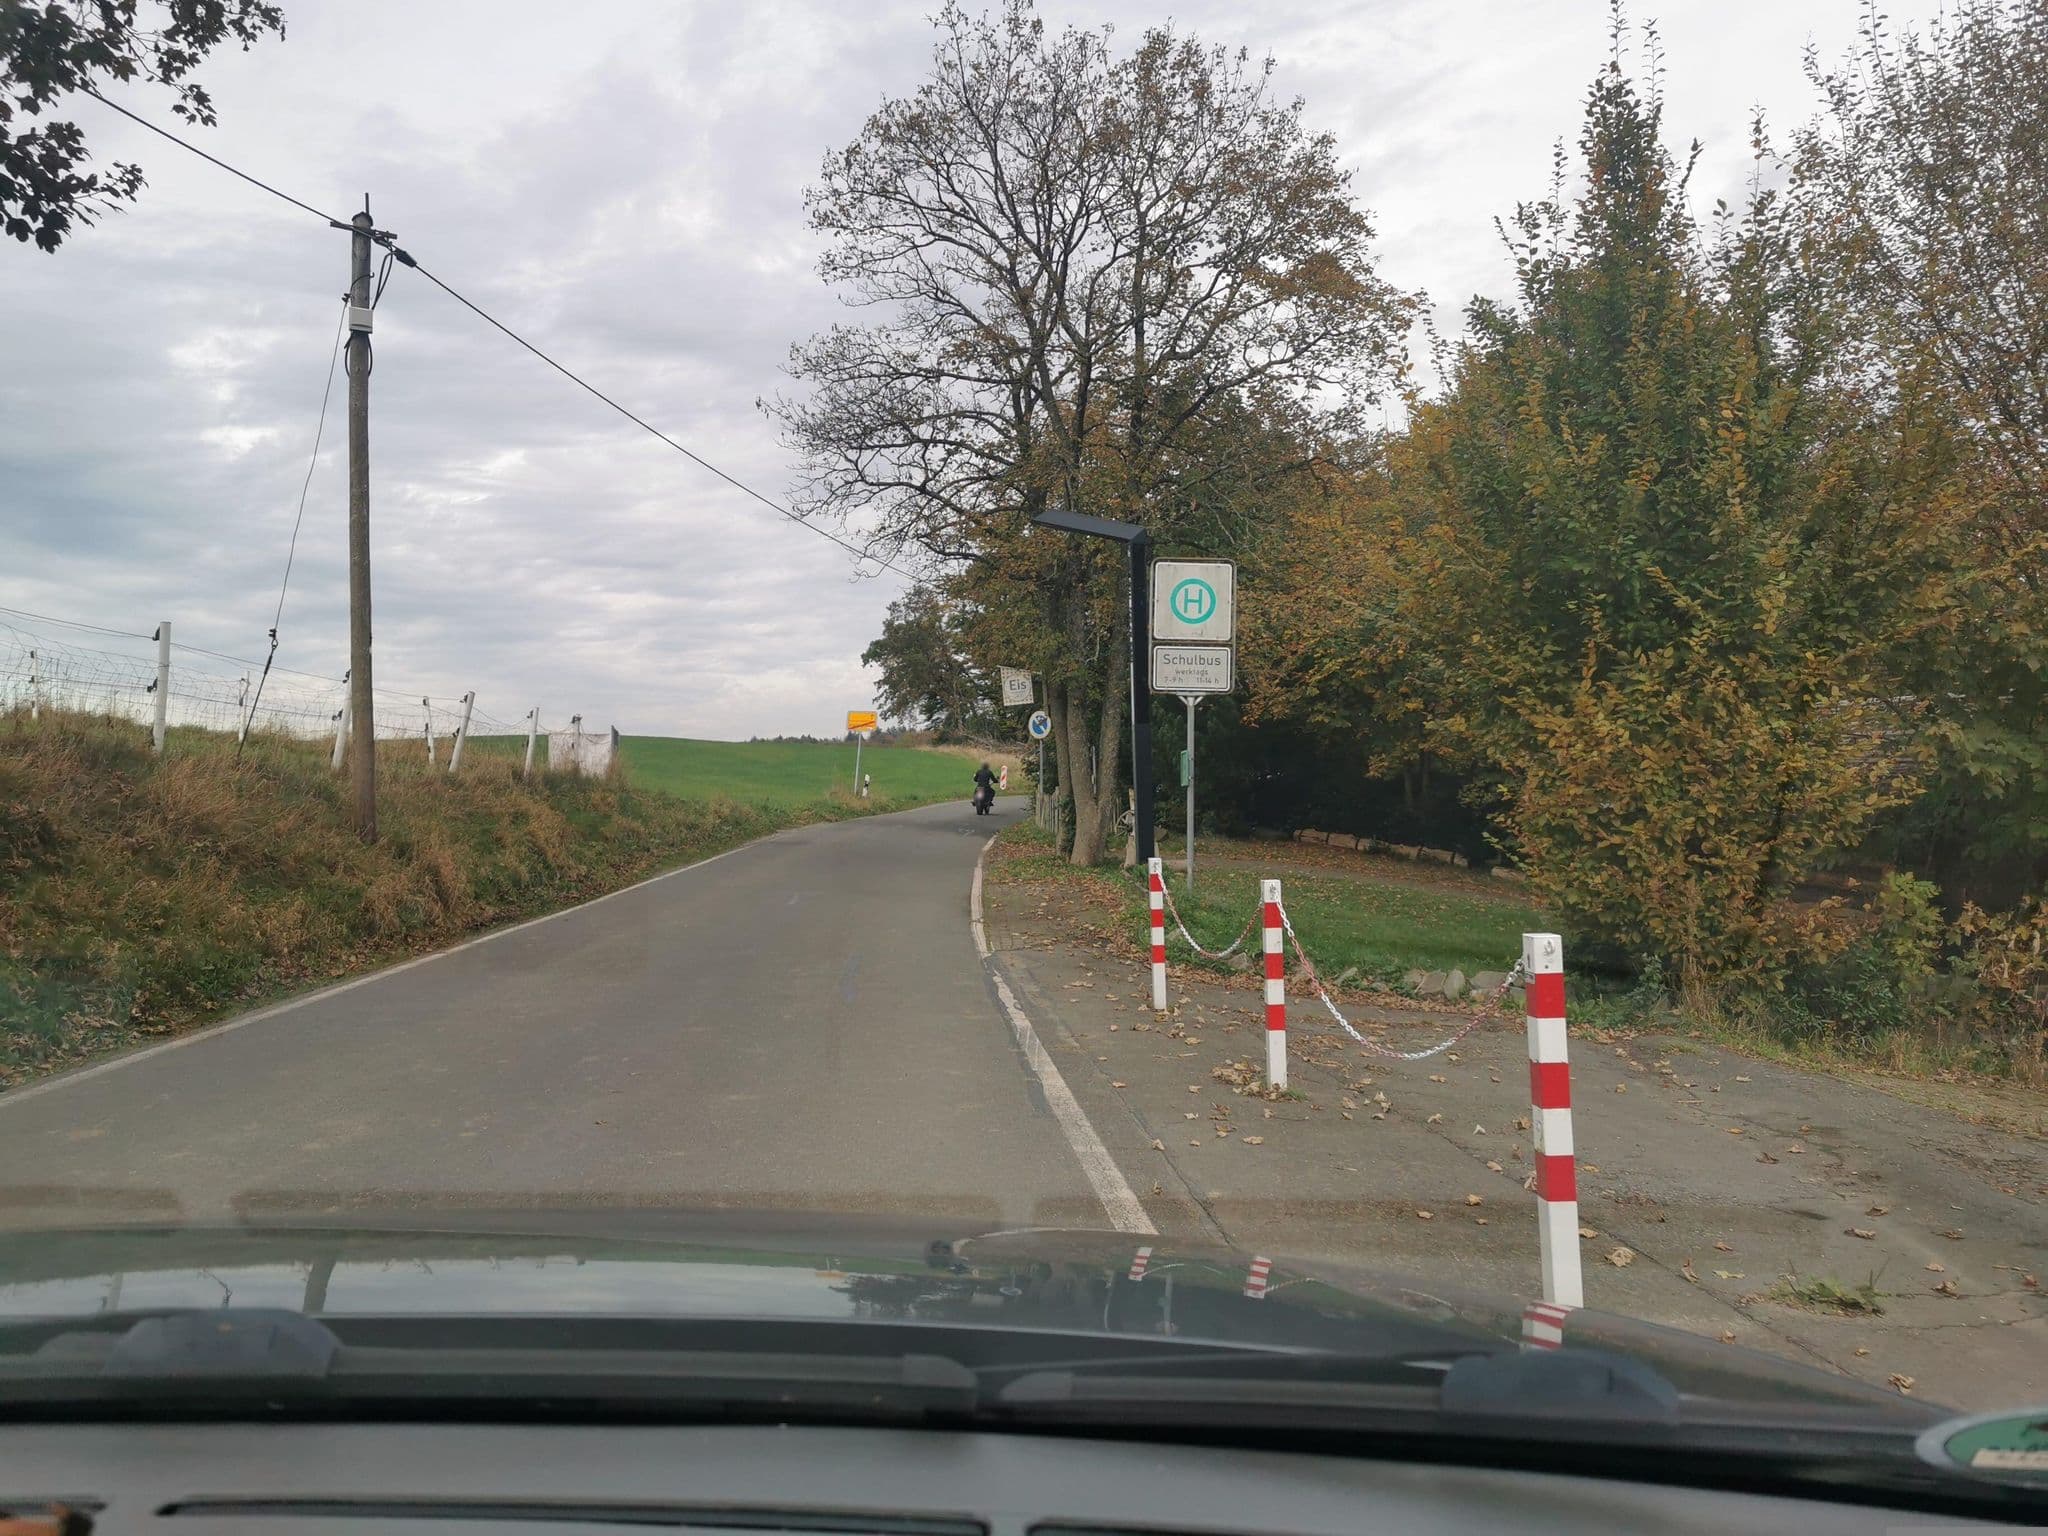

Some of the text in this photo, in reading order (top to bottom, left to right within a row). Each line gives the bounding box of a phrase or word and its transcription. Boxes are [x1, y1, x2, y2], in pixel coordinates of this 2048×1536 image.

[1184, 588, 1203, 614] H
[1163, 653, 1222, 666] Schulbus
[1009, 678, 1027, 691] Eis
